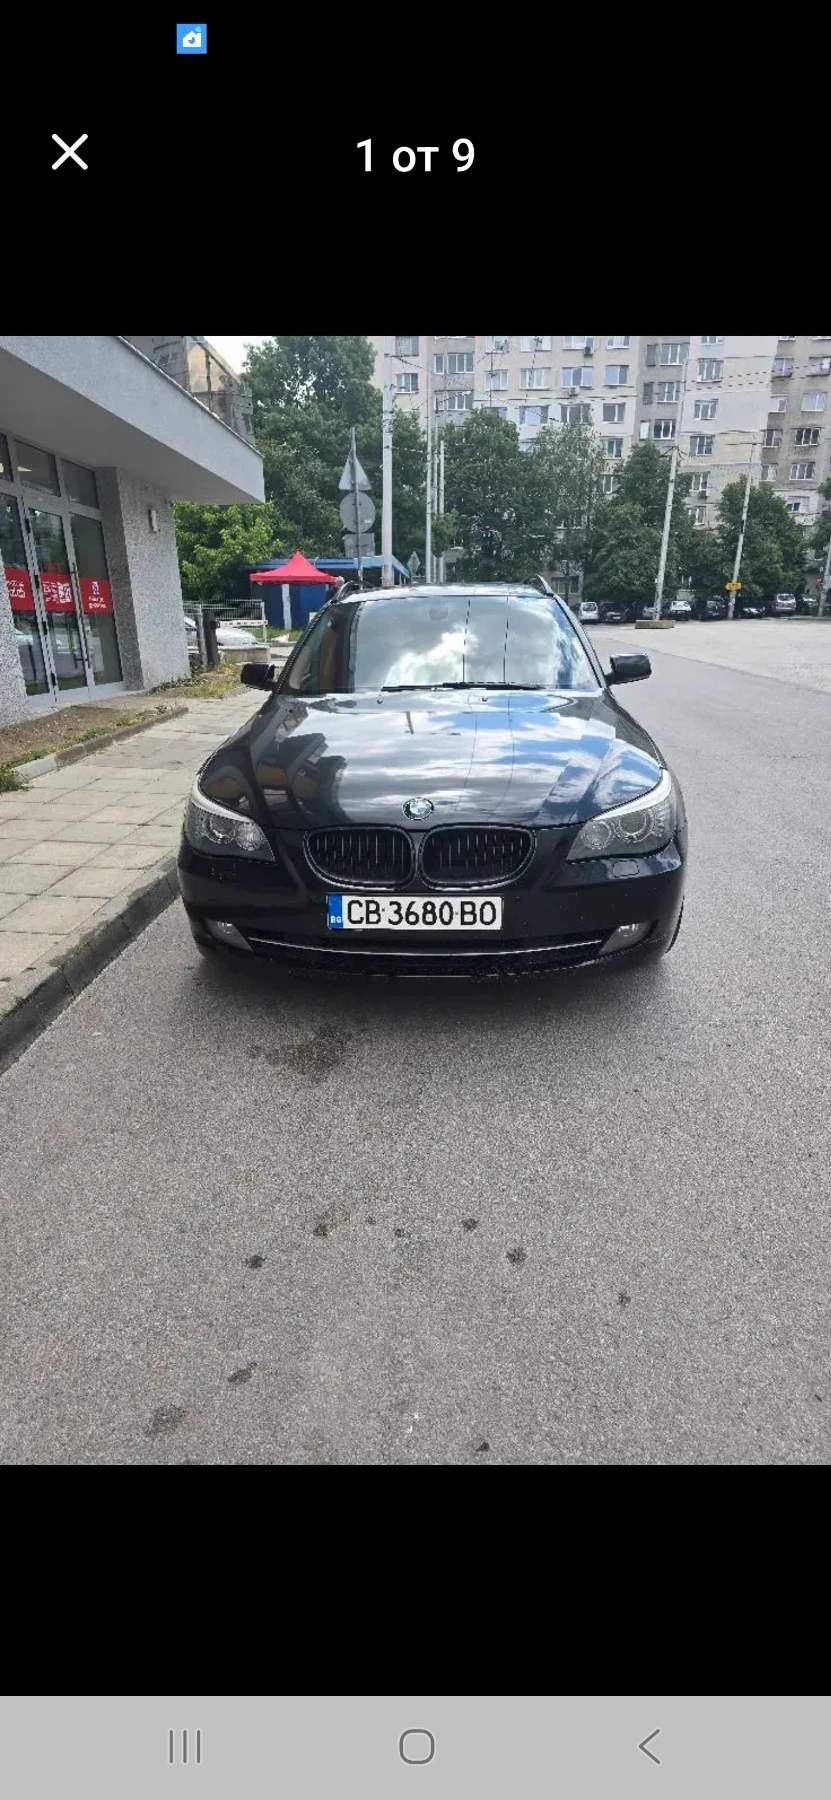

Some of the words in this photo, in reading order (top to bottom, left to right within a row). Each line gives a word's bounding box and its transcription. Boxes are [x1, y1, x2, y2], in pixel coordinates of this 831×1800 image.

[347, 899, 382, 925] CB
[387, 900, 454, 926] 3680
[460, 900, 497, 926] BO
